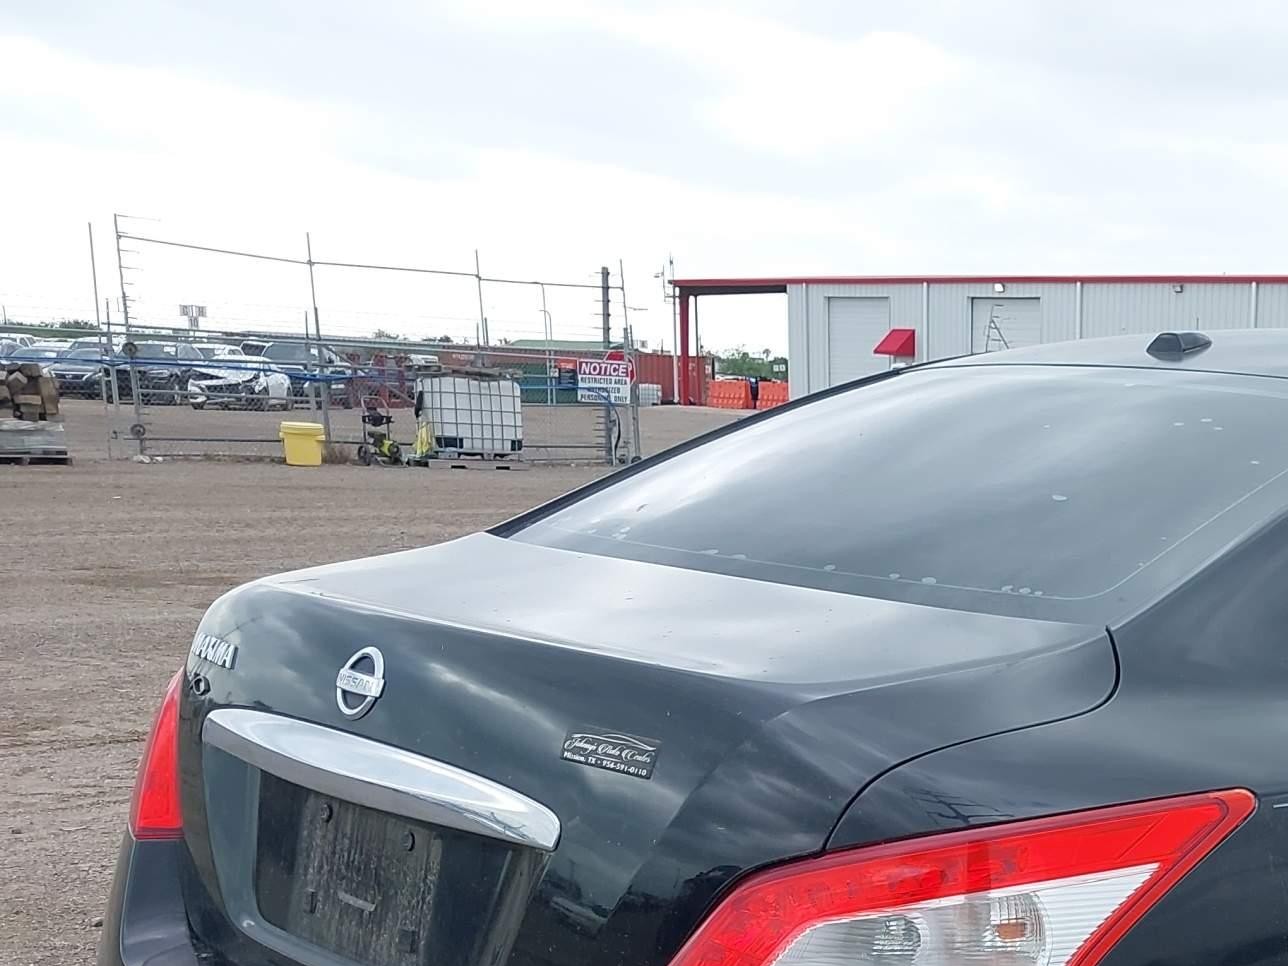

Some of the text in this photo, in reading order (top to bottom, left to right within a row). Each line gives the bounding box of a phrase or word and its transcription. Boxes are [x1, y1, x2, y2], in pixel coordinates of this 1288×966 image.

[580, 362, 627, 376] NOTICE
[580, 376, 628, 386] RESTRICTED AREA
[614, 395, 627, 403] ONLY
[588, 756, 597, 765] TX
